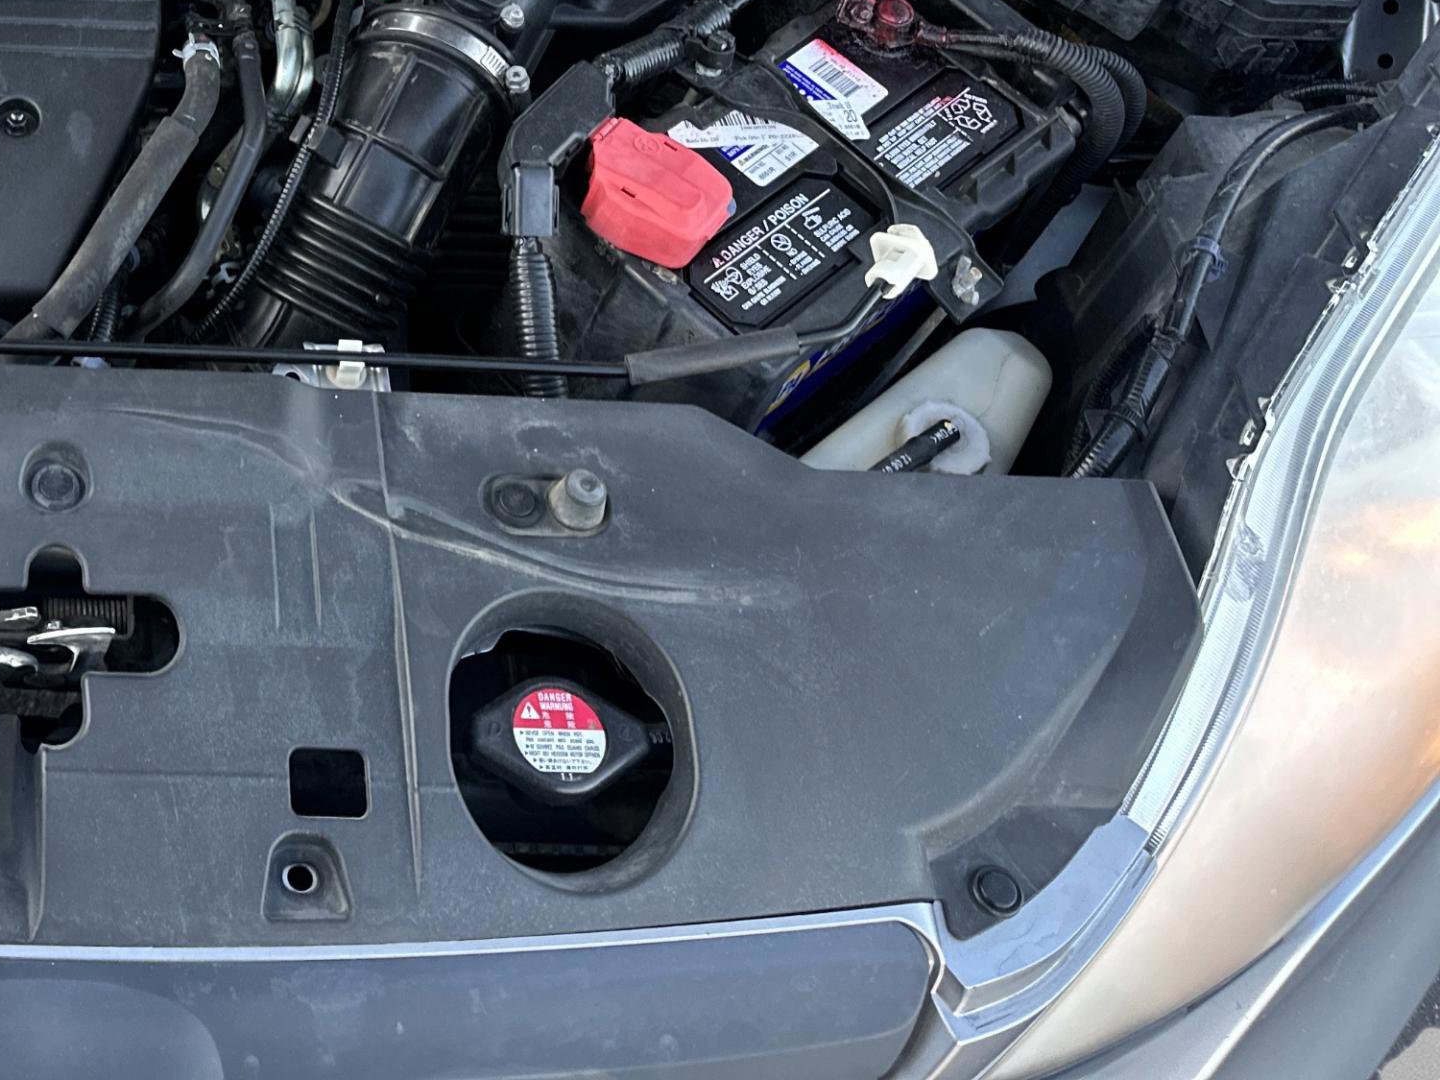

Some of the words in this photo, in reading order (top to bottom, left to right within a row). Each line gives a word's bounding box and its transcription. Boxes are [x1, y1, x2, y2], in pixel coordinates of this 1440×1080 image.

[843, 109, 858, 123] 20
[721, 226, 765, 262] DANGER
[767, 193, 810, 226] POISON
[740, 253, 762, 269] SHIELD
[538, 692, 572, 702] DANGER
